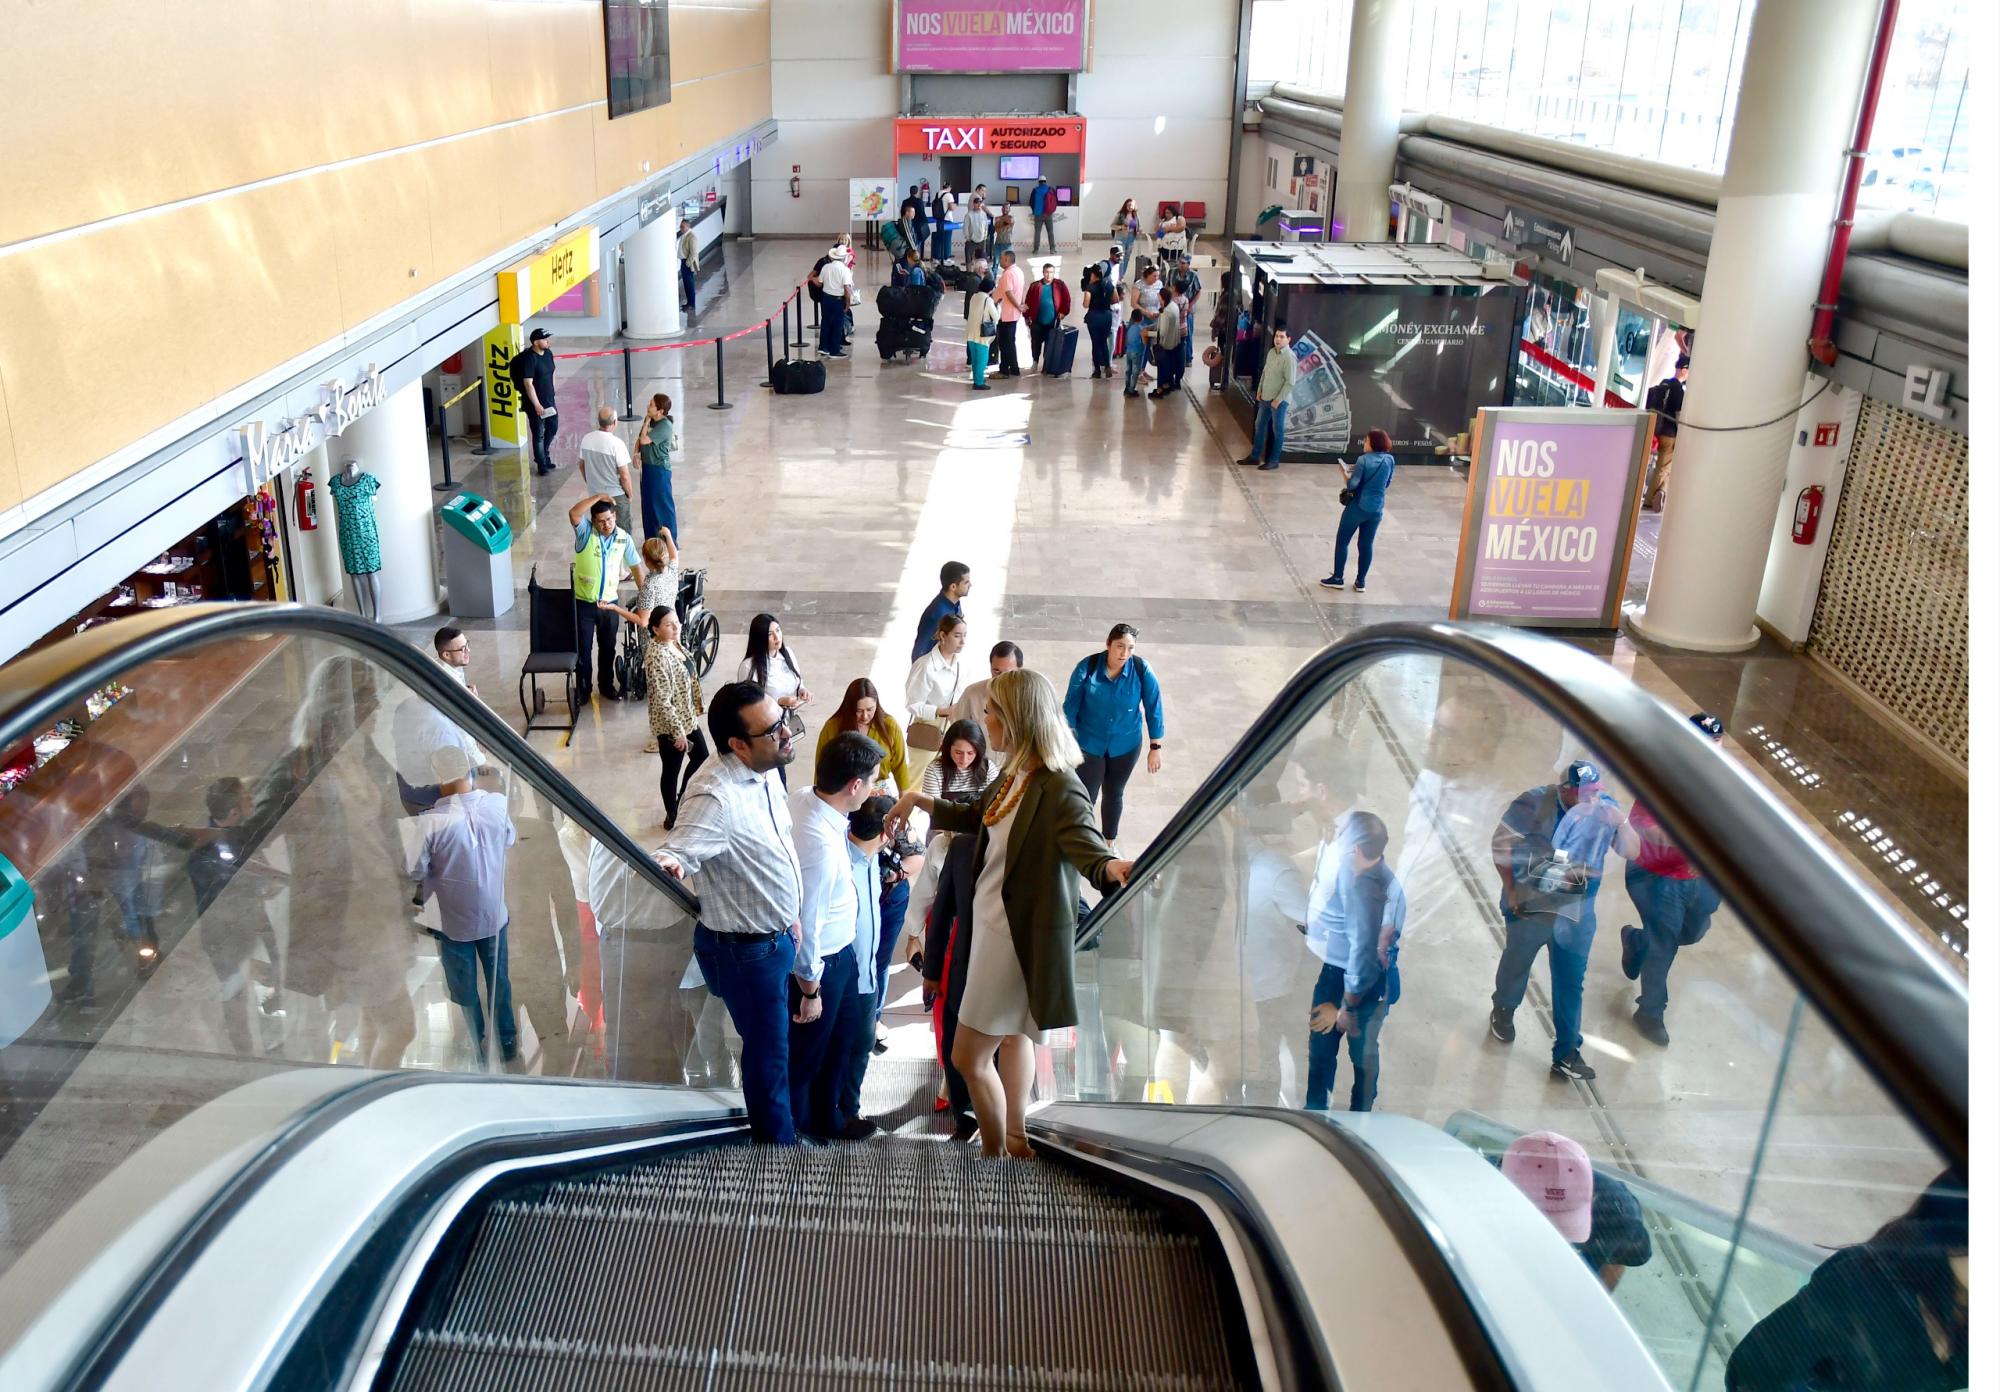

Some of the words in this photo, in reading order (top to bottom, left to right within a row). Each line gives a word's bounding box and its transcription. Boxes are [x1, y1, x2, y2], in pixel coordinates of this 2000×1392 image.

[906, 13, 941, 36] NOS
[946, 12, 1002, 34] VUELA
[1006, 8, 1074, 35] MÉXICO
[922, 127, 984, 150] TAXI
[990, 127, 1066, 137] AUTORIZADO
[990, 140, 999, 149] Y
[1000, 140, 1047, 149] SEGURO
[551, 248, 573, 285] Hertz
[1423, 324, 1486, 336] EXCHANGE
[488, 343, 514, 418] Hertz
[1902, 365, 1946, 420] EL
[1496, 438, 1558, 478] NOS
[1493, 479, 1584, 516] VUELA
[1484, 518, 1598, 562] MÉXICO
